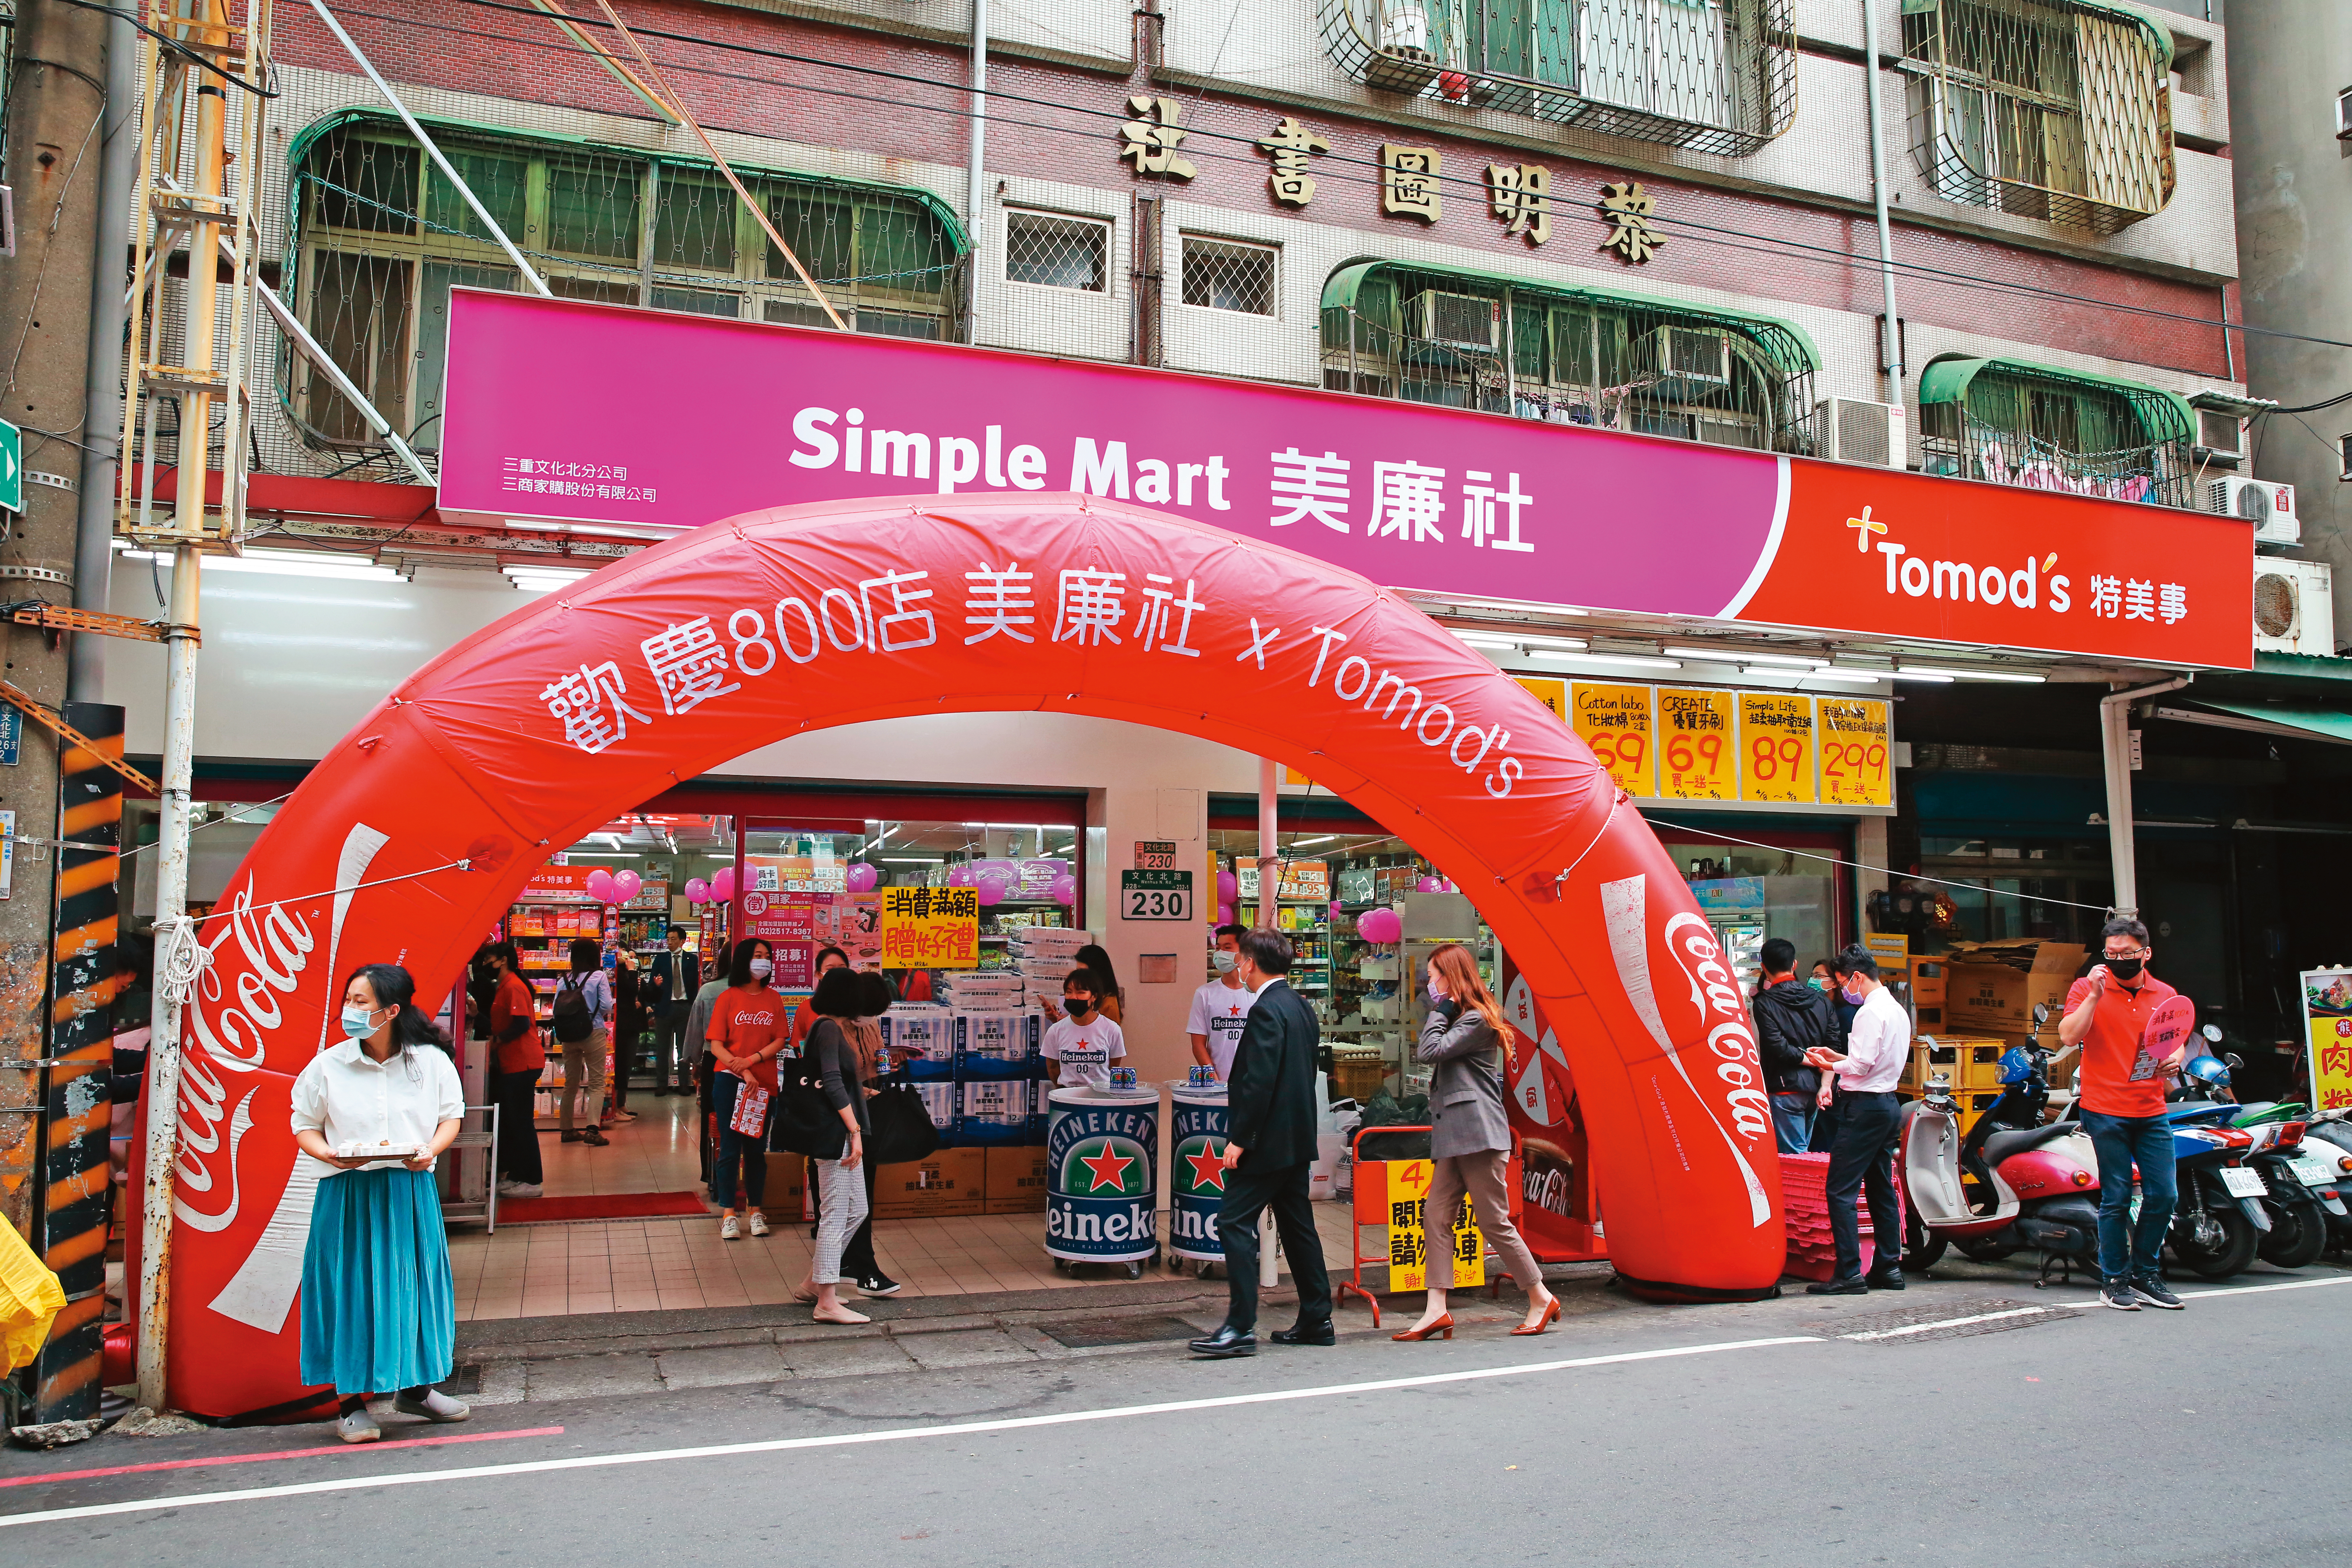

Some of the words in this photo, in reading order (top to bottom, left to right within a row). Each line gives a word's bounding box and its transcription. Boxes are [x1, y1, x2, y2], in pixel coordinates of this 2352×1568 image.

[503, 457, 628, 481] 三重文化北分公司
[788, 407, 1047, 494] Simple
[1069, 437, 1232, 511] Mart
[502, 476, 657, 503] 三商家購股份有限公司
[1270, 447, 1535, 552] 美廉社
[1877, 541, 2071, 613] Tomod's
[2090, 574, 2187, 625] 特美事
[539, 568, 938, 754] 歡慶800店
[964, 561, 1205, 658] 美廉社
[1308, 626, 1524, 798] Tomod's
[1578, 691, 1617, 710] Cotton
[1621, 694, 1644, 710] labo
[1662, 696, 1715, 712] CREATE
[1745, 700, 1774, 713] Simple
[1779, 700, 1798, 712] Life
[1672, 711, 1724, 731] 優質牙刷
[1666, 733, 1722, 775] 69
[1752, 736, 1803, 782] 89
[1824, 742, 1886, 782] 299
[1672, 773, 1722, 788] 買一送一
[1831, 780, 1879, 795] 買一送一
[1145, 844, 1175, 852] 文化北路
[1147, 855, 1173, 869] 230
[547, 875, 572, 884] 特美事
[1132, 871, 1182, 880] 文化北路
[747, 895, 763, 911] 徵
[768, 893, 791, 904] 頭家
[886, 887, 977, 919] 消費滿額
[1131, 892, 1183, 916] 230
[885, 921, 976, 961] 贈好禮
[735, 1010, 774, 1026] Coca-Cola
[2146, 1031, 2158, 1047] 送
[1062, 1053, 1105, 1062] Heineken
[1049, 1112, 1151, 1169] HEINEKEN
